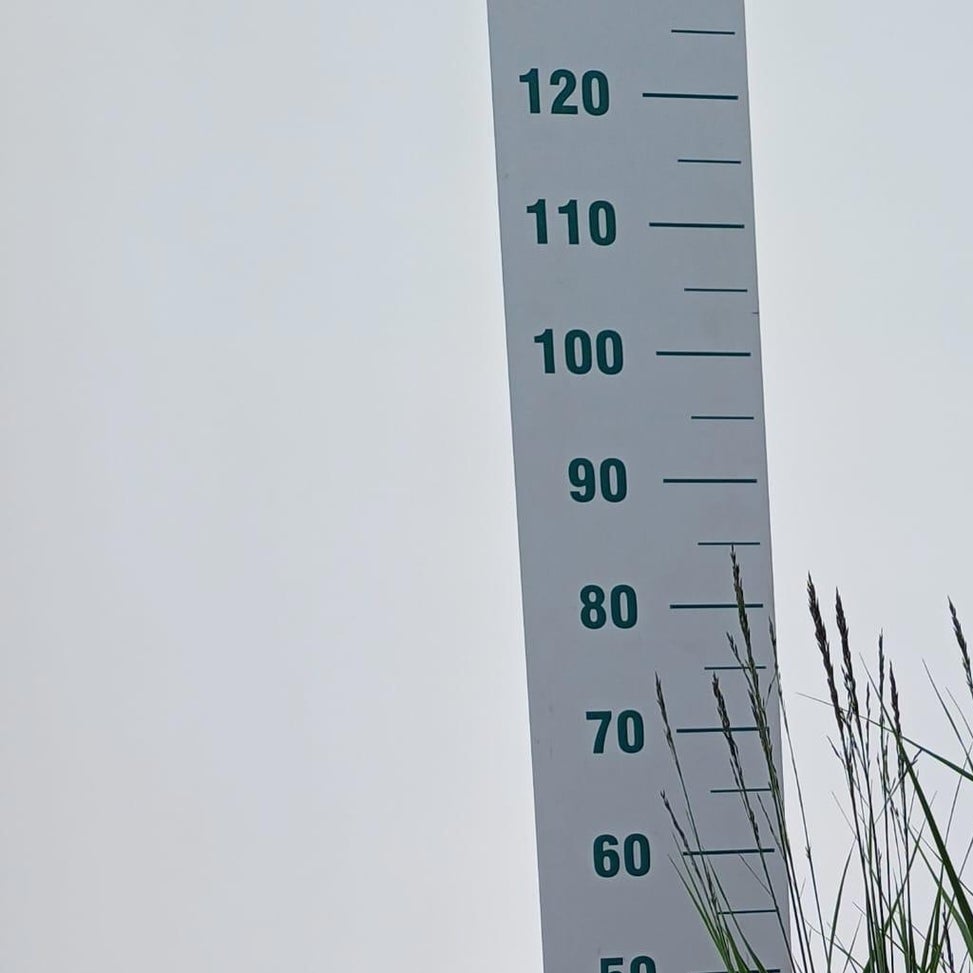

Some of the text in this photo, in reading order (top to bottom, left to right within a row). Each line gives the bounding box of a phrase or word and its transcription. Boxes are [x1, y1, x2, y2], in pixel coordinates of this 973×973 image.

[518, 67, 610, 117] 120
[526, 198, 617, 247] 110
[533, 328, 624, 376] 100
[567, 457, 628, 504] 90
[579, 584, 638, 630] 80
[585, 709, 645, 755] 70
[592, 832, 652, 879] 60
